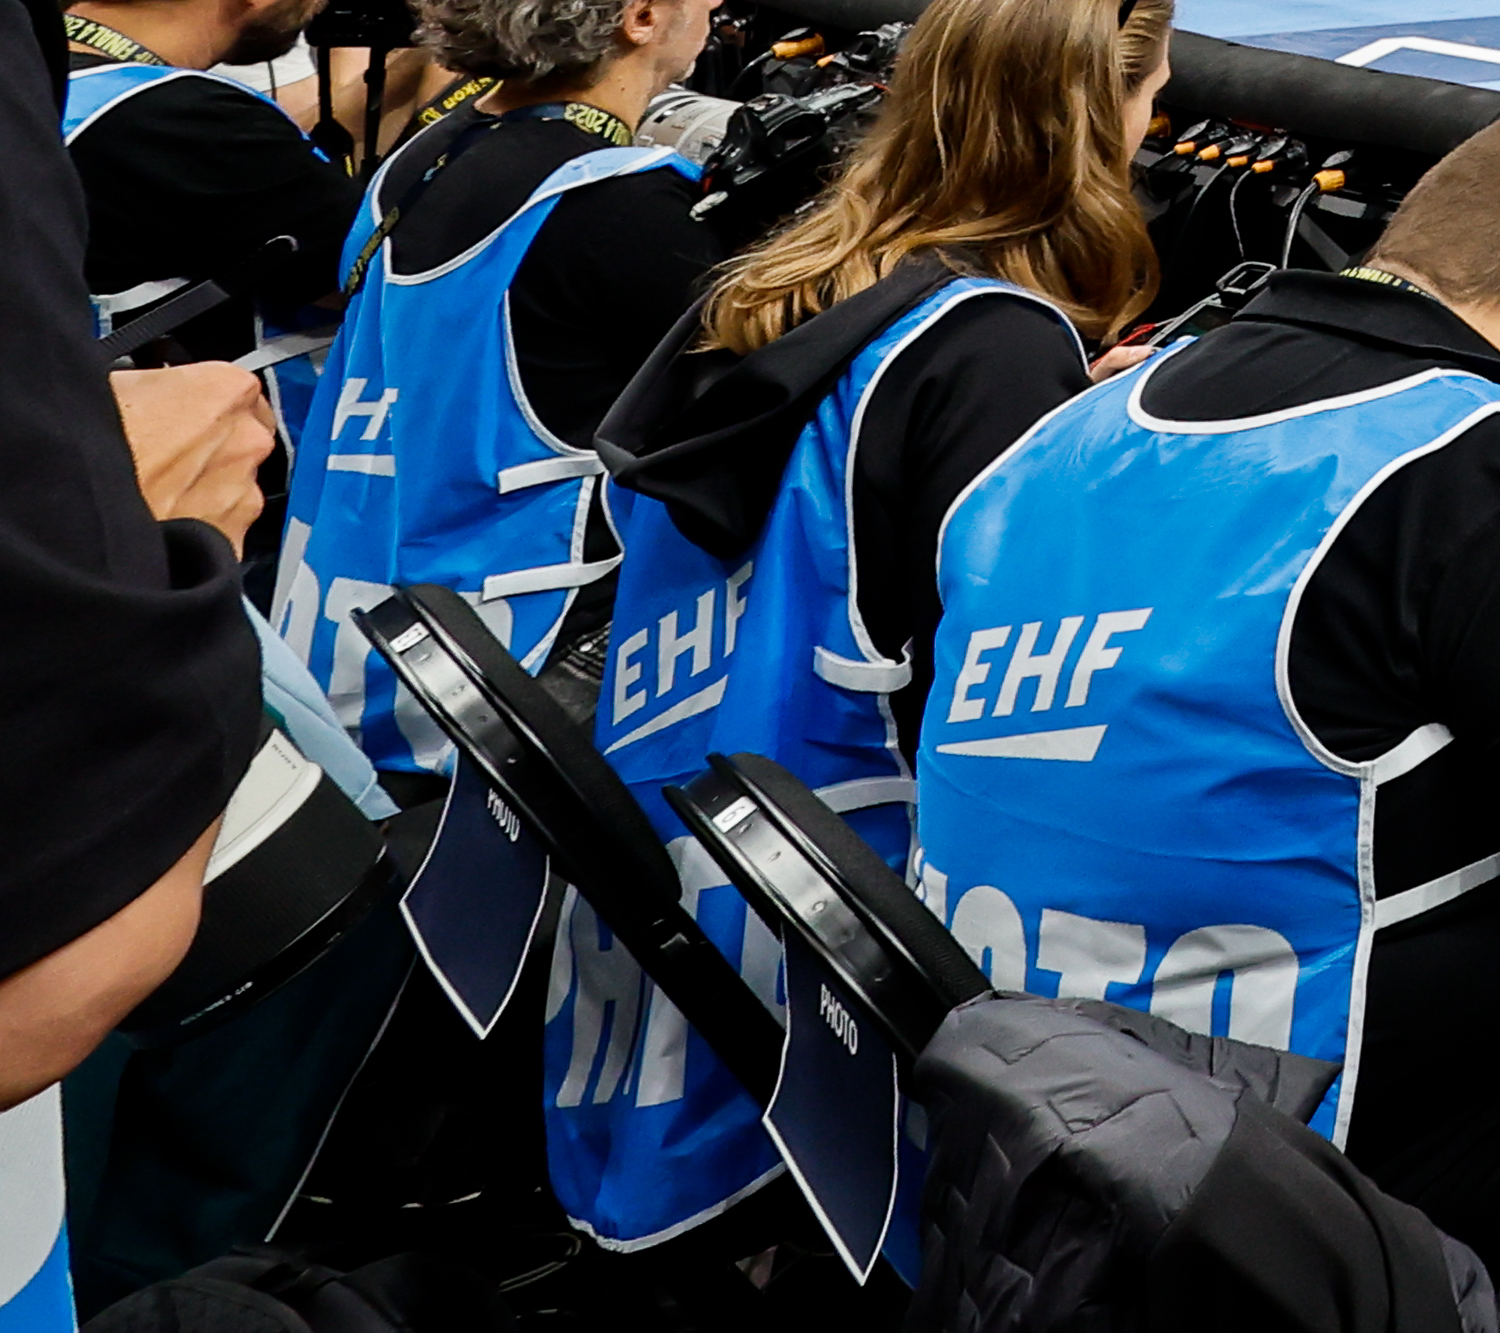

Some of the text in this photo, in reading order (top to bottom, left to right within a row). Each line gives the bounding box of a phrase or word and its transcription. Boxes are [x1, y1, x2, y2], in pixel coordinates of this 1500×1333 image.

[612, 560, 755, 727] EHF
[946, 607, 1153, 724] EHF
[820, 983, 858, 1056] PHOTO
